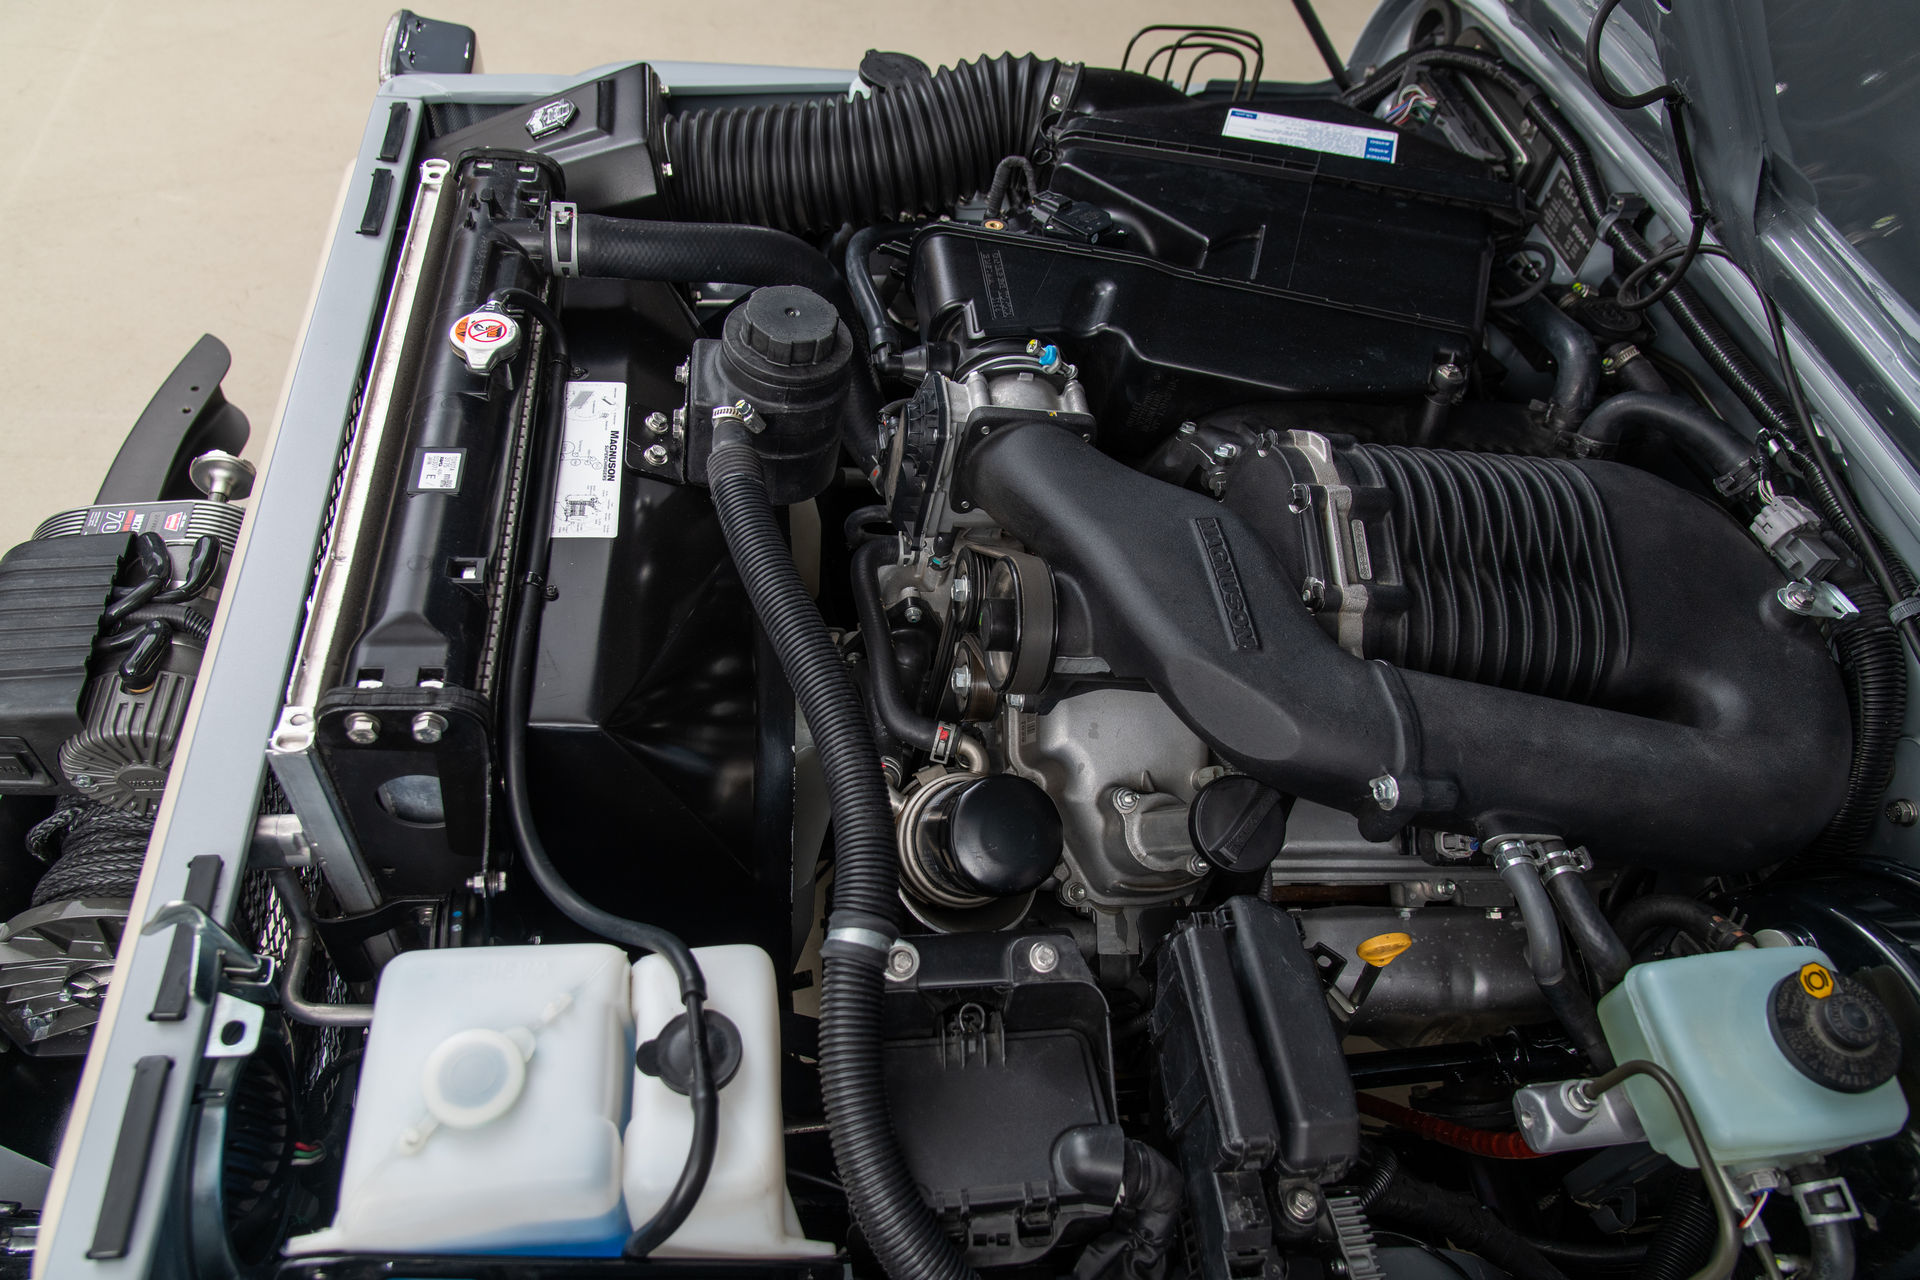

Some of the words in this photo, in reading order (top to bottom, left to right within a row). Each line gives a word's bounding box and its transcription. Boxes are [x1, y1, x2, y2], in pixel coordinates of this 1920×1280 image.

[607, 430, 620, 482] MAGNUSON
[101, 510, 126, 534] 70
[1199, 517, 1257, 650] MAGNUSON
